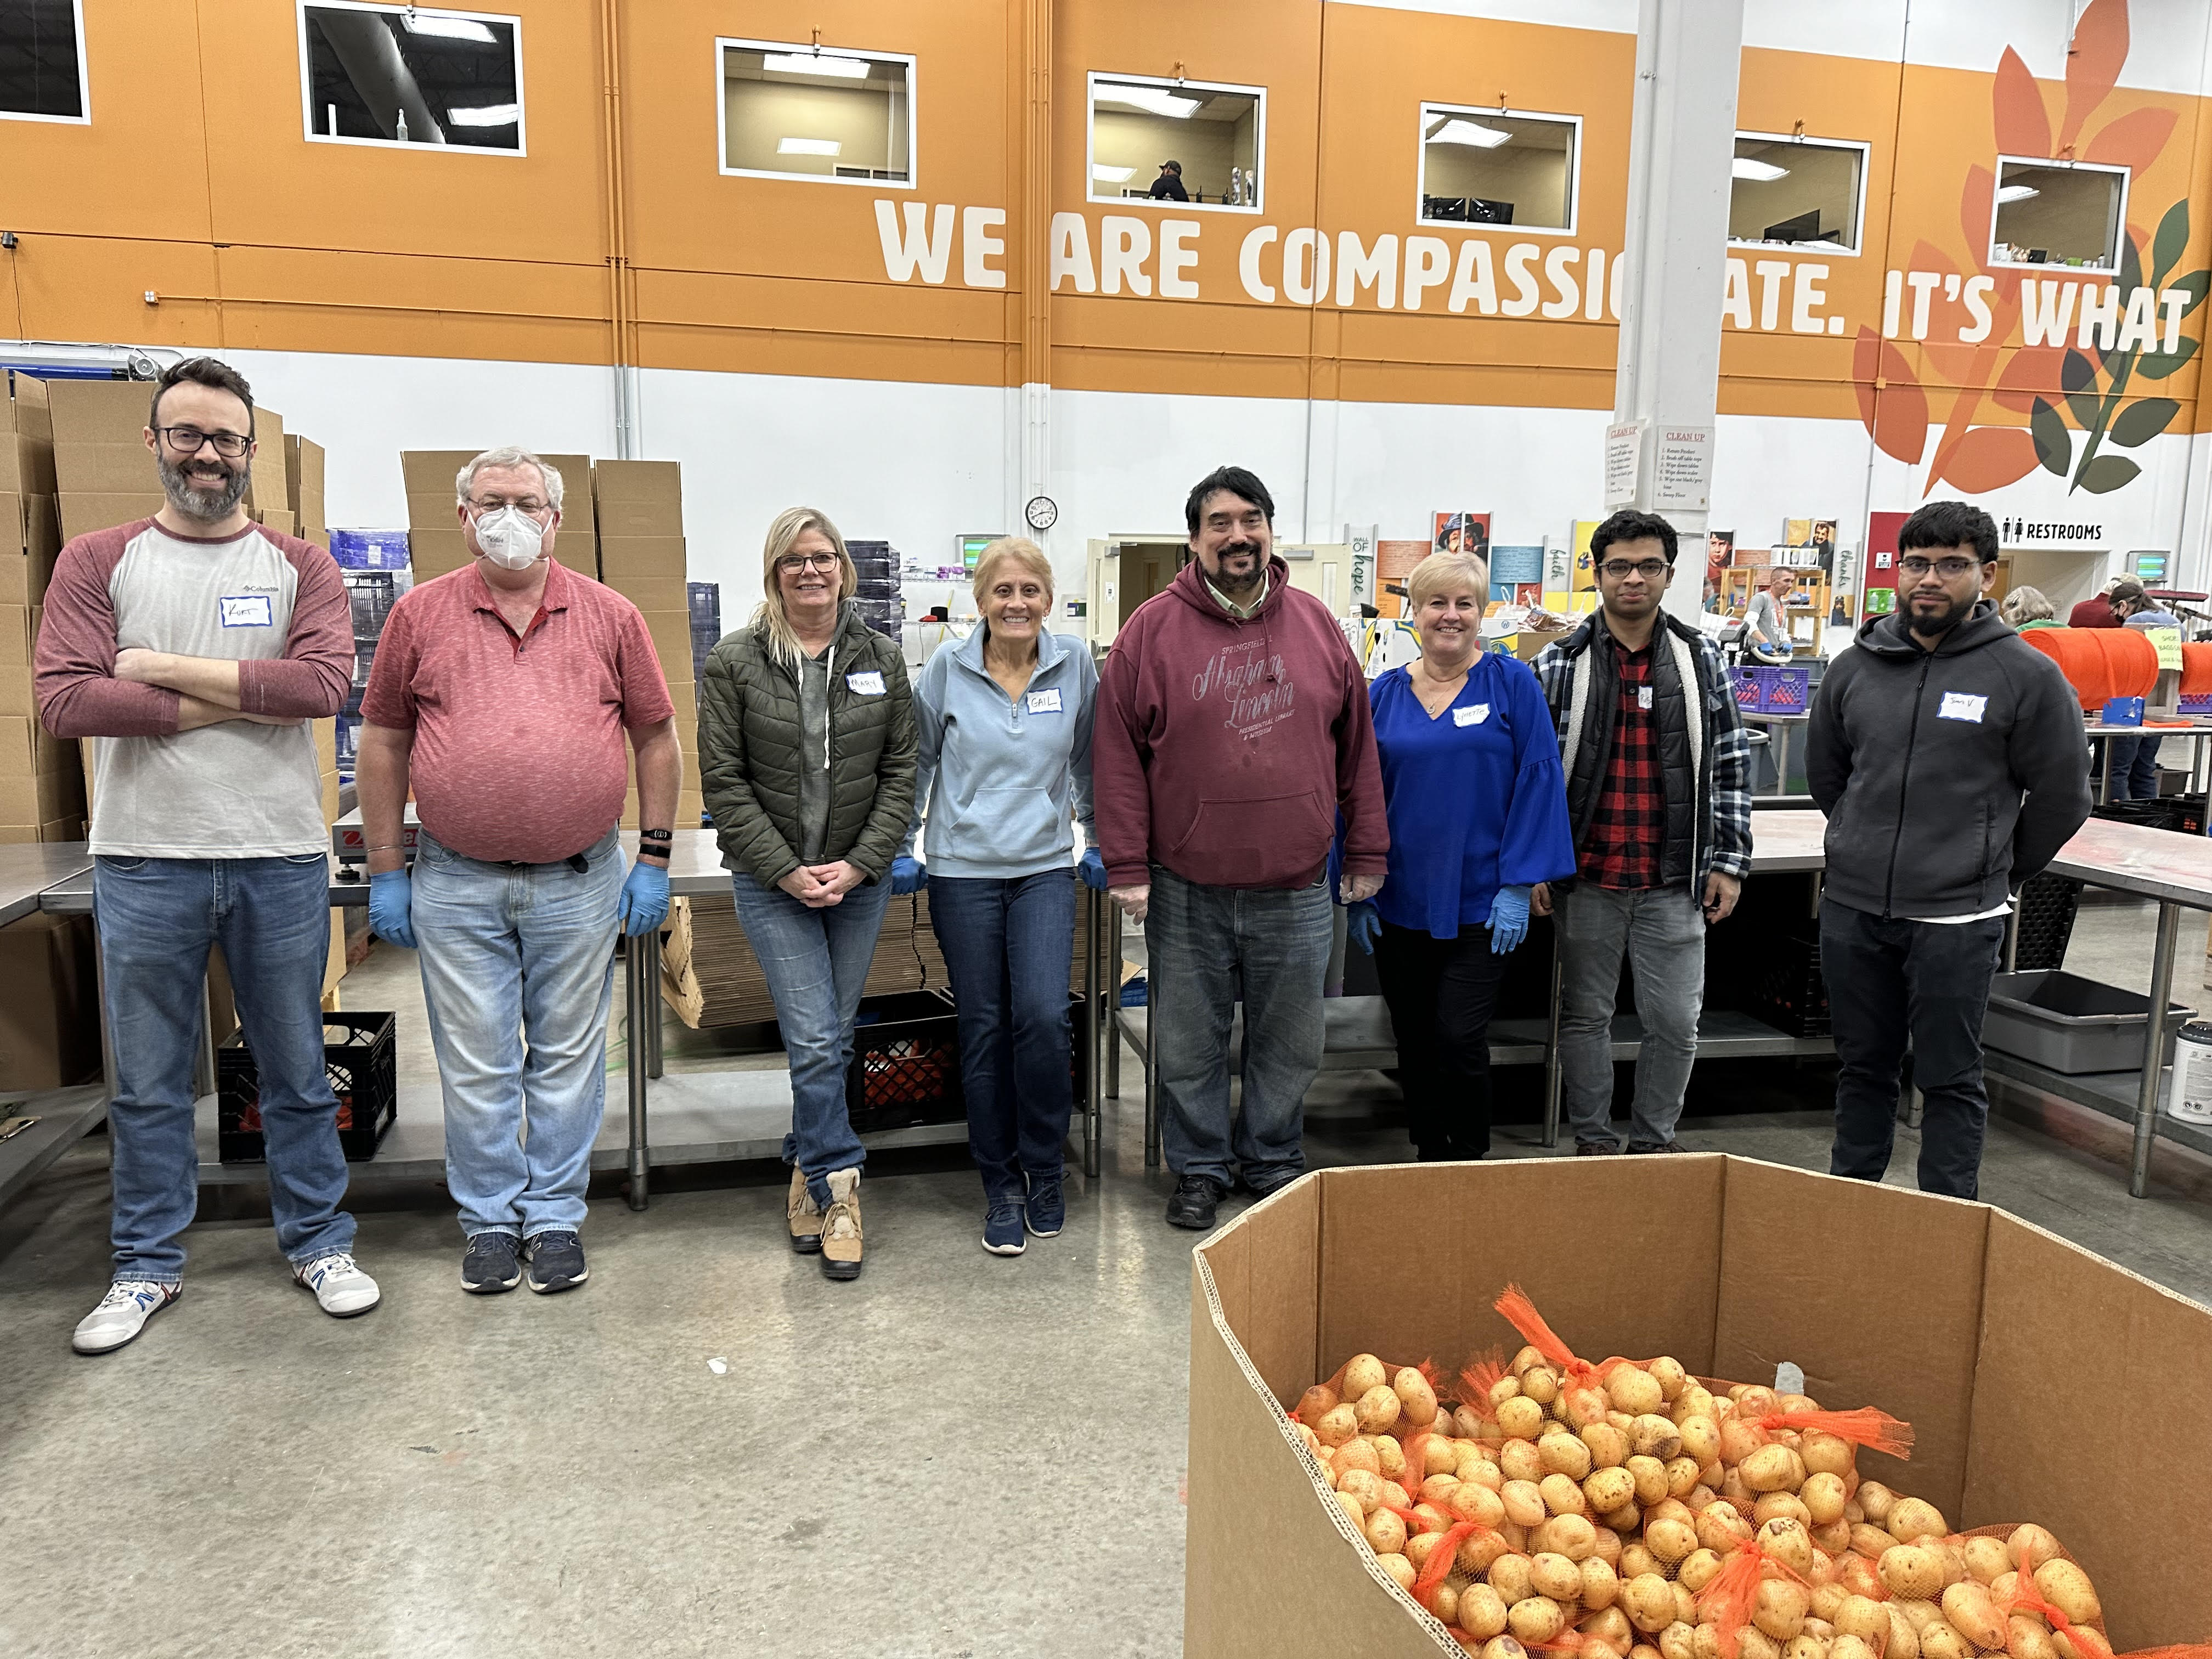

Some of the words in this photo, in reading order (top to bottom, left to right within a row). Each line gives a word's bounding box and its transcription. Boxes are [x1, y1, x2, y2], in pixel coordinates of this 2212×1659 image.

[874, 199, 1007, 288] WE
[1051, 211, 1201, 299] ARE
[1882, 269, 1994, 344] IT'S
[2021, 276, 2192, 355] WHAT
[1666, 432, 1692, 441] CLEAN
[2027, 523, 2102, 540] RESTROOMS
[1353, 542, 1369, 551] OF
[1351, 554, 1374, 595] hope
[1838, 550, 1854, 588] thanks
[1221, 637, 1266, 655] SPRINGFIELD
[1193, 651, 1286, 701] Abraham
[1031, 696, 1058, 708] GAIL
[1224, 681, 1294, 729] Lincoln
